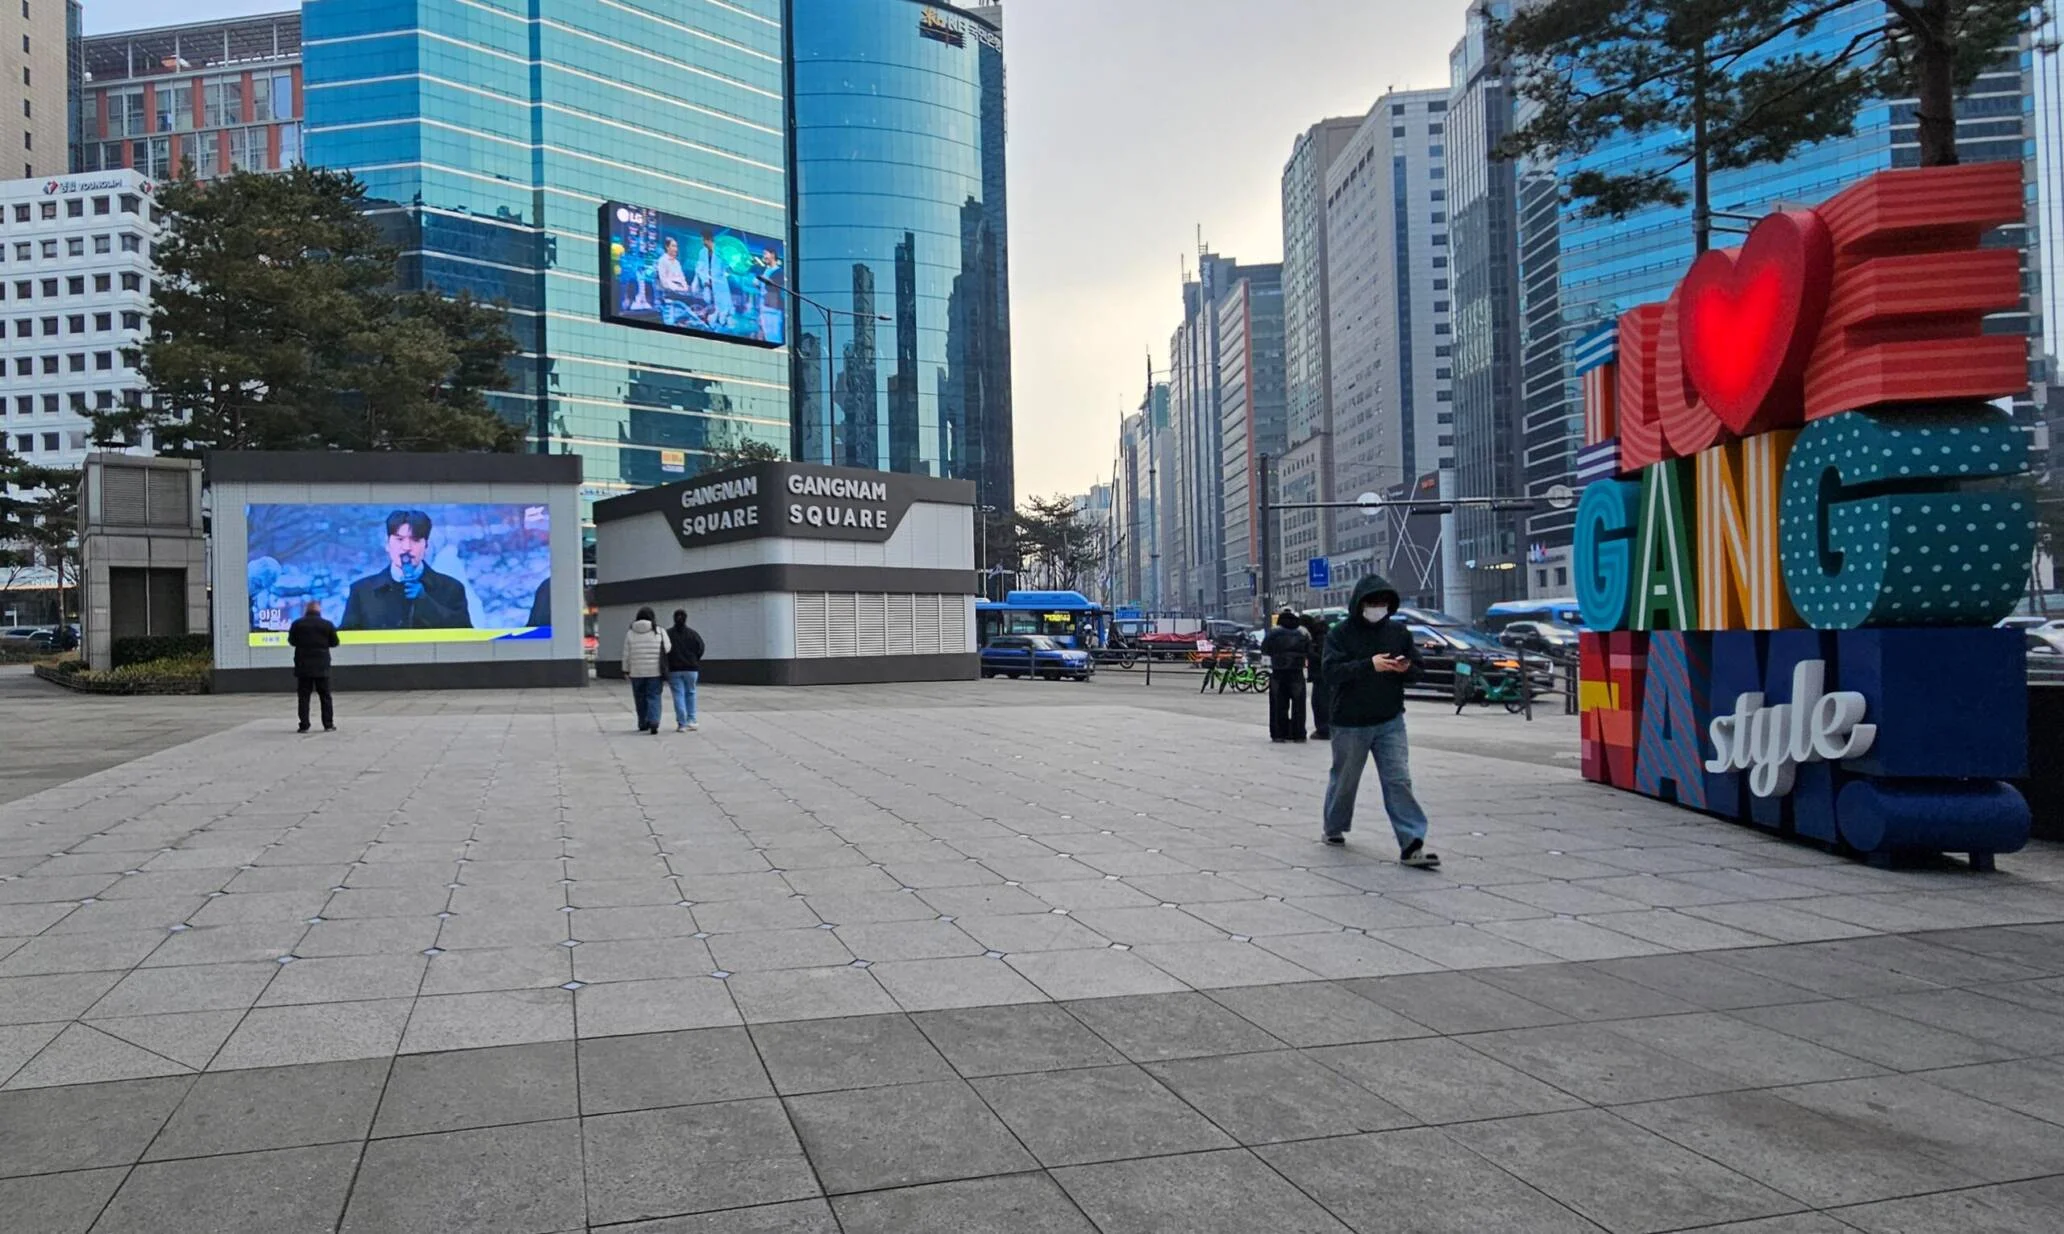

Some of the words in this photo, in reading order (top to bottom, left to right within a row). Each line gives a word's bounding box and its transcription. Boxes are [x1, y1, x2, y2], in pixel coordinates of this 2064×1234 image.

[629, 212, 643, 224] LG
[681, 475, 758, 508] GANGNAM
[787, 474, 887, 501] GANGNAM
[682, 505, 759, 536] SQUARE
[789, 503, 888, 529] SQUARE
[1574, 402, 2033, 631] GANG
[1705, 659, 1877, 798] style
